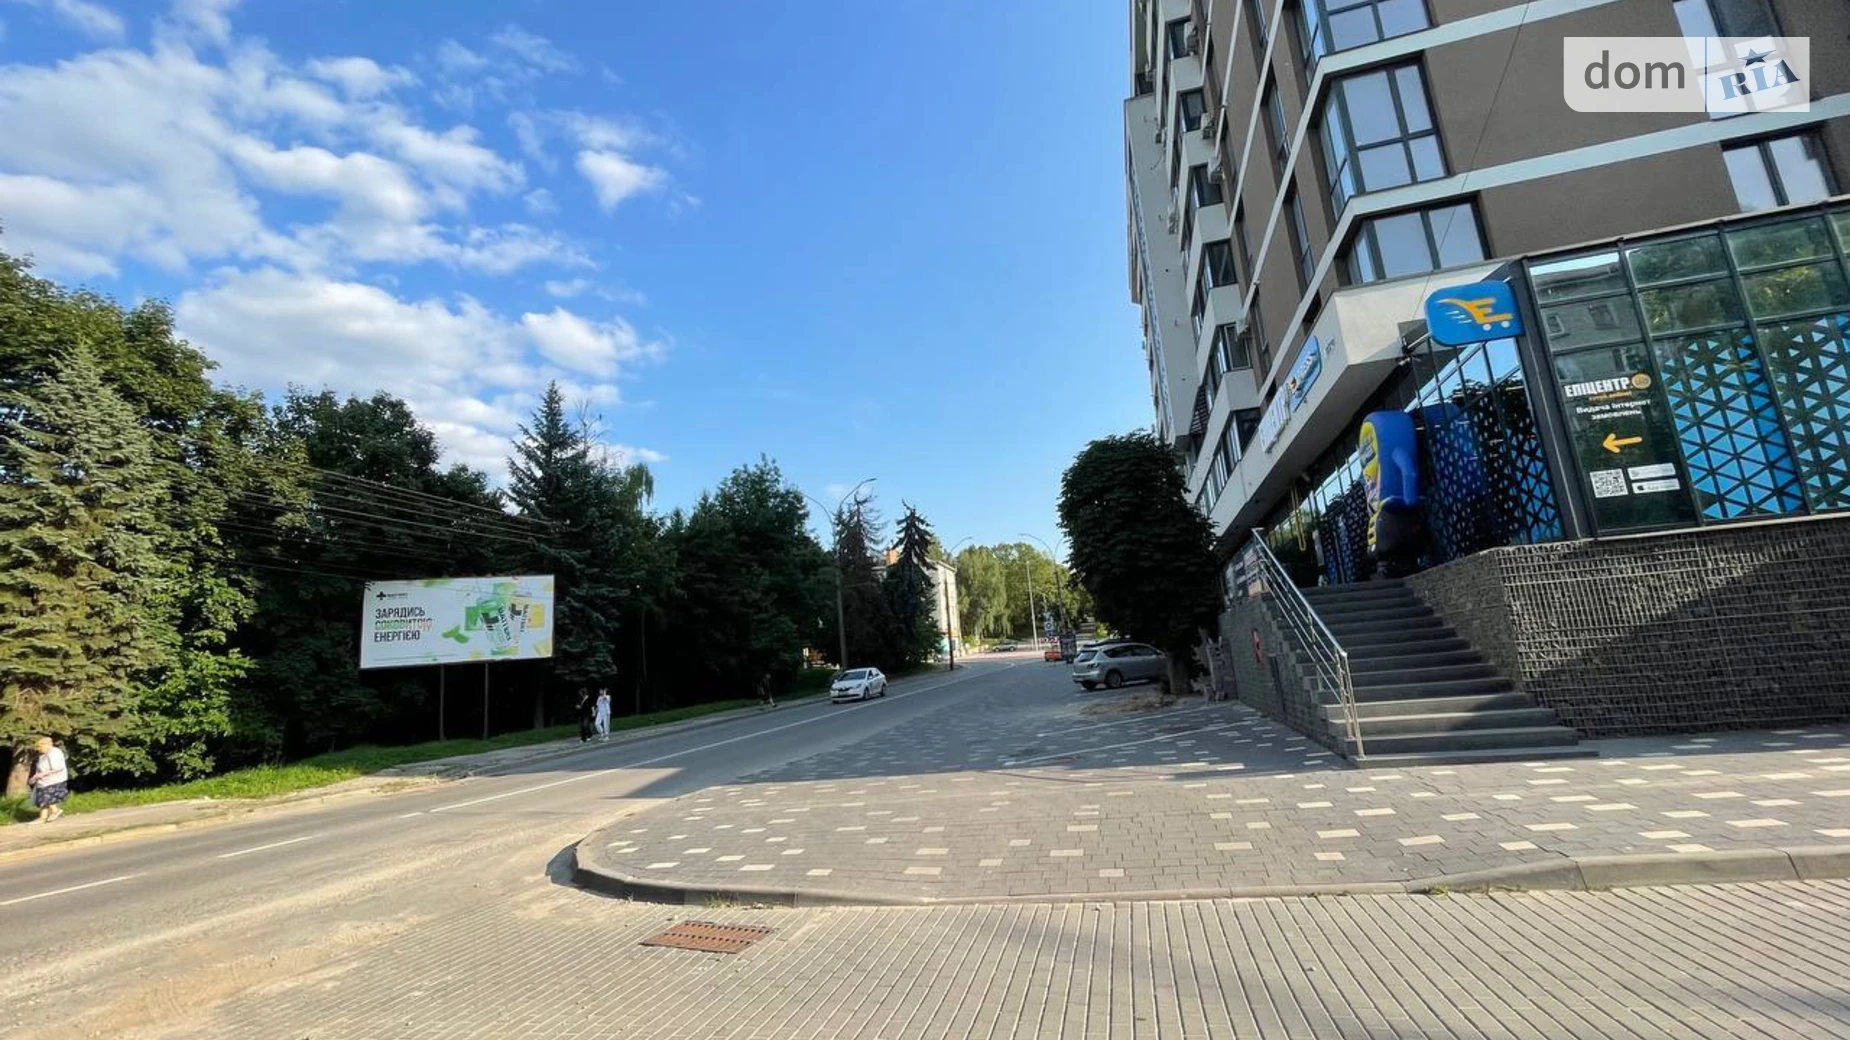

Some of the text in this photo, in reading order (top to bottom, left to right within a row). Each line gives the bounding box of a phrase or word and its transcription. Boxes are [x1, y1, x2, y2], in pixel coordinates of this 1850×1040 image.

[1576, 404, 1610, 414] Видача
[375, 607, 425, 619] ЗАРЯДИСЬ
[374, 630, 420, 643] ЕНЕРГІЄЮ
